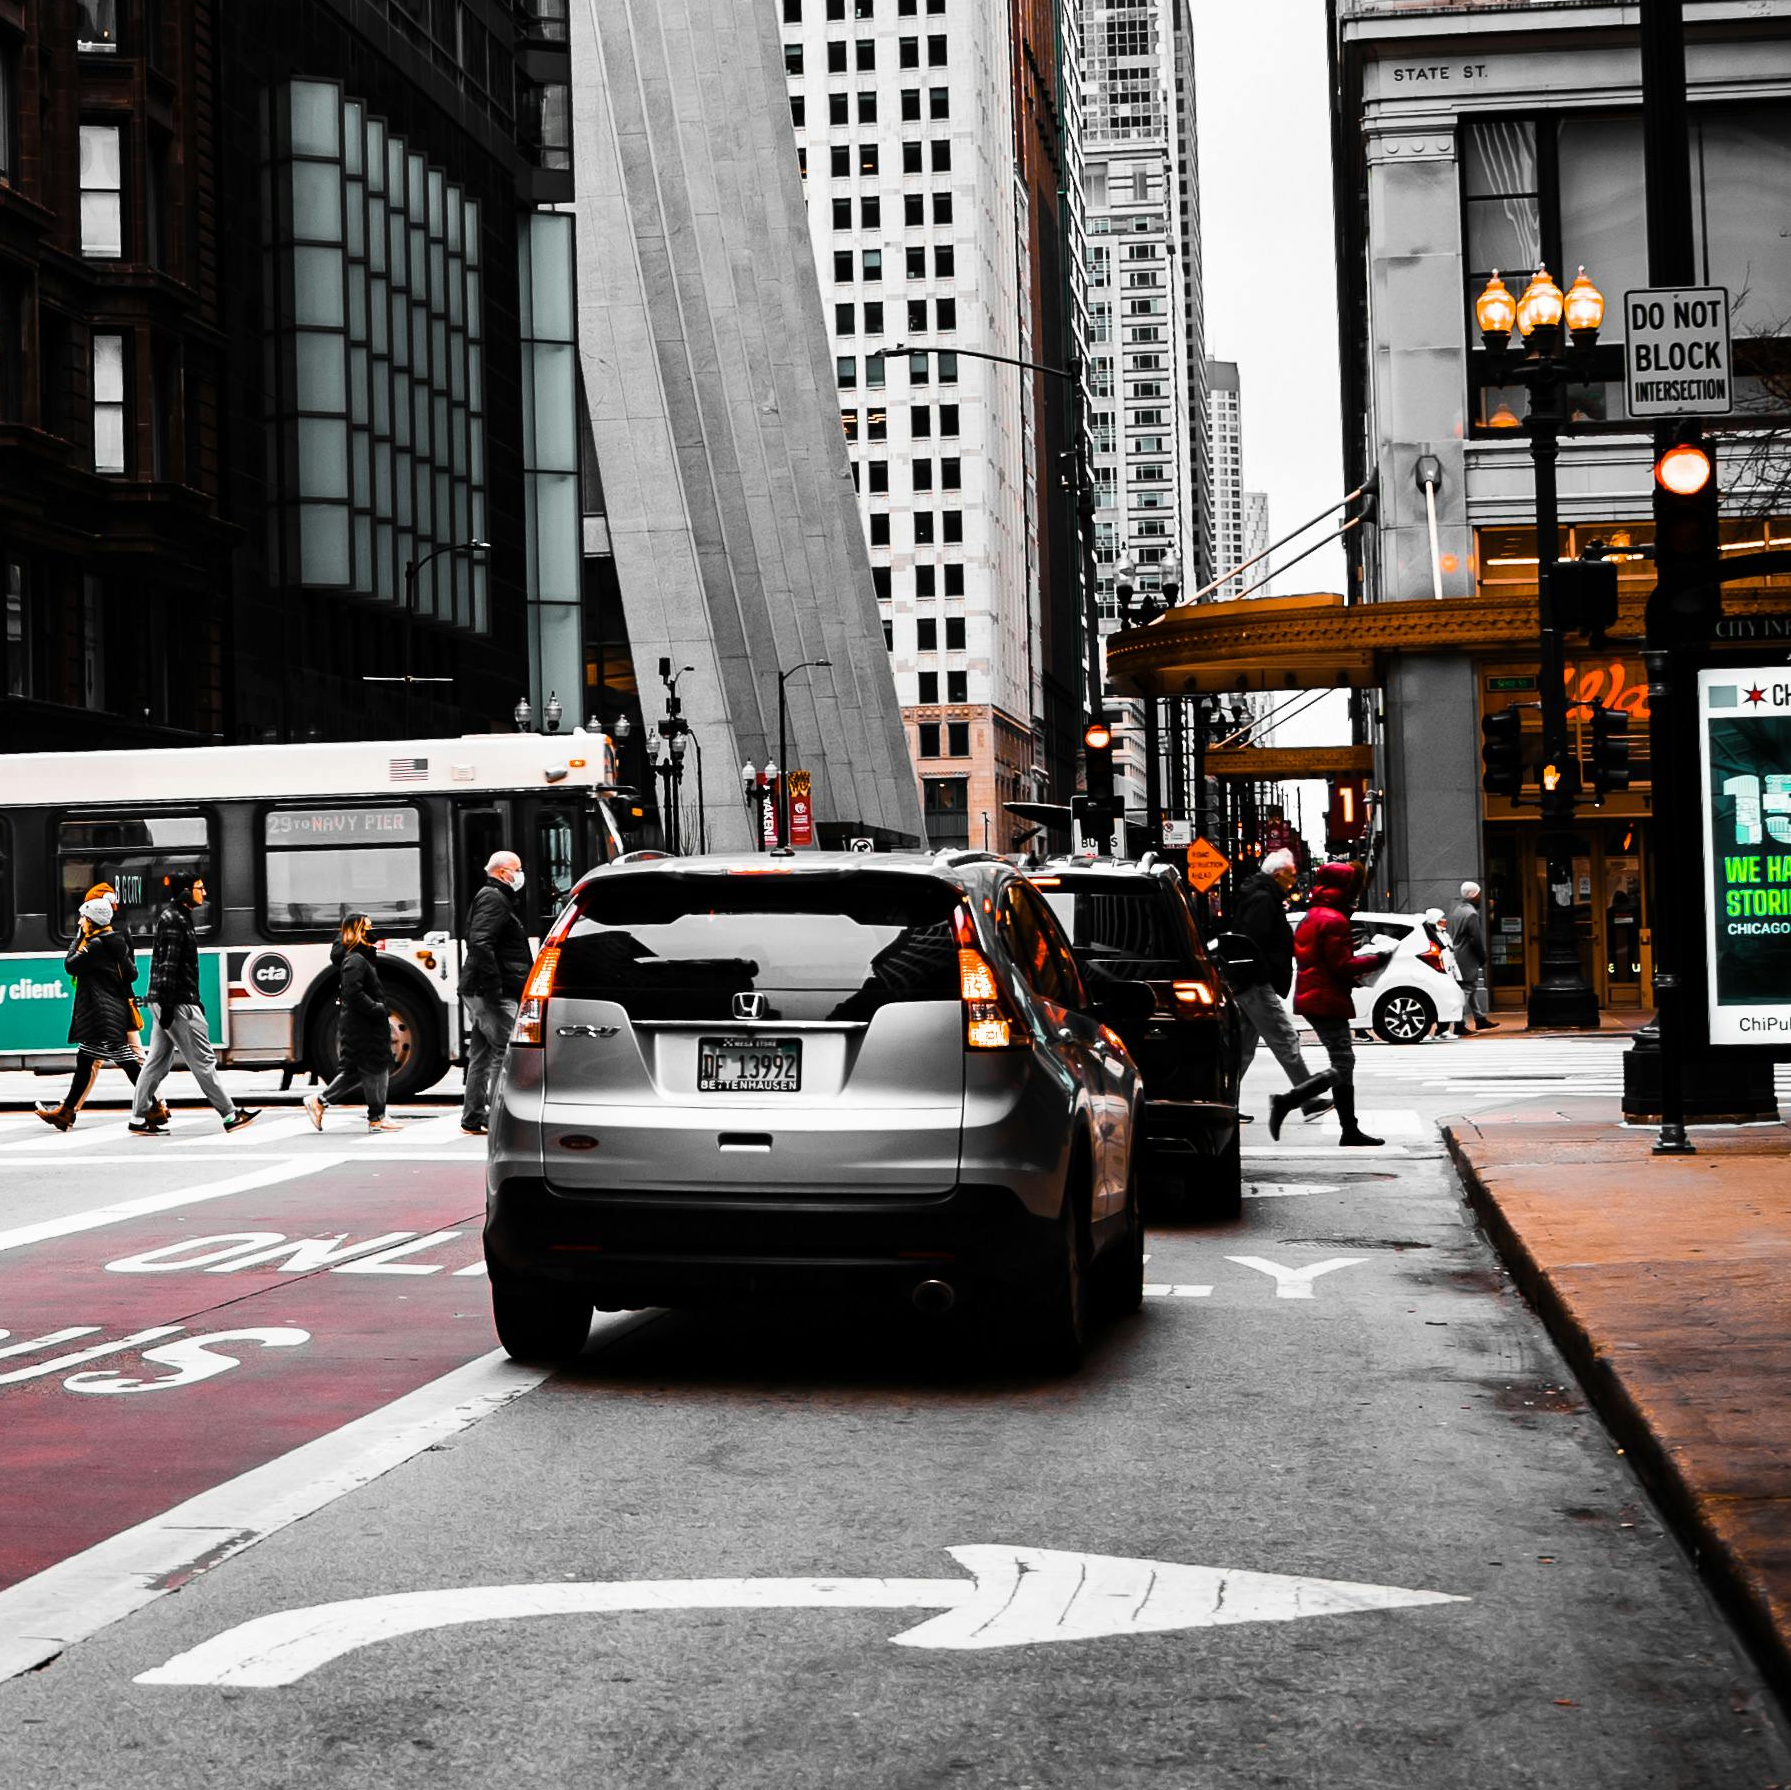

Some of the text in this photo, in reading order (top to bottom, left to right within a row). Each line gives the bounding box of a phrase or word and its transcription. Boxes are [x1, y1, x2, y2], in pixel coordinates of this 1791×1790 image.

[1393, 65, 1488, 82] STATE ST.
[1631, 300, 1721, 331] DO NOT
[1635, 341, 1722, 372] BLOCK
[1635, 378, 1726, 402] INTERSECTION
[1716, 619, 1756, 638] CITY
[268, 816, 292, 834] 29
[312, 815, 357, 832] NAVY
[365, 813, 404, 830] PIER
[1725, 856, 1762, 884] WE
[128, 875, 142, 905] CITY
[1726, 888, 1791, 917] STORI
[1727, 921, 1791, 936] CHICAGO
[256, 965, 288, 981] cta
[9, 978, 69, 1001] client.
[1739, 1017, 1791, 1032] ChiPu
[736, 1053, 796, 1079] 13992
[700, 1079, 797, 1090] BETTENHAUSEN
[105, 1231, 489, 1277] ONL
